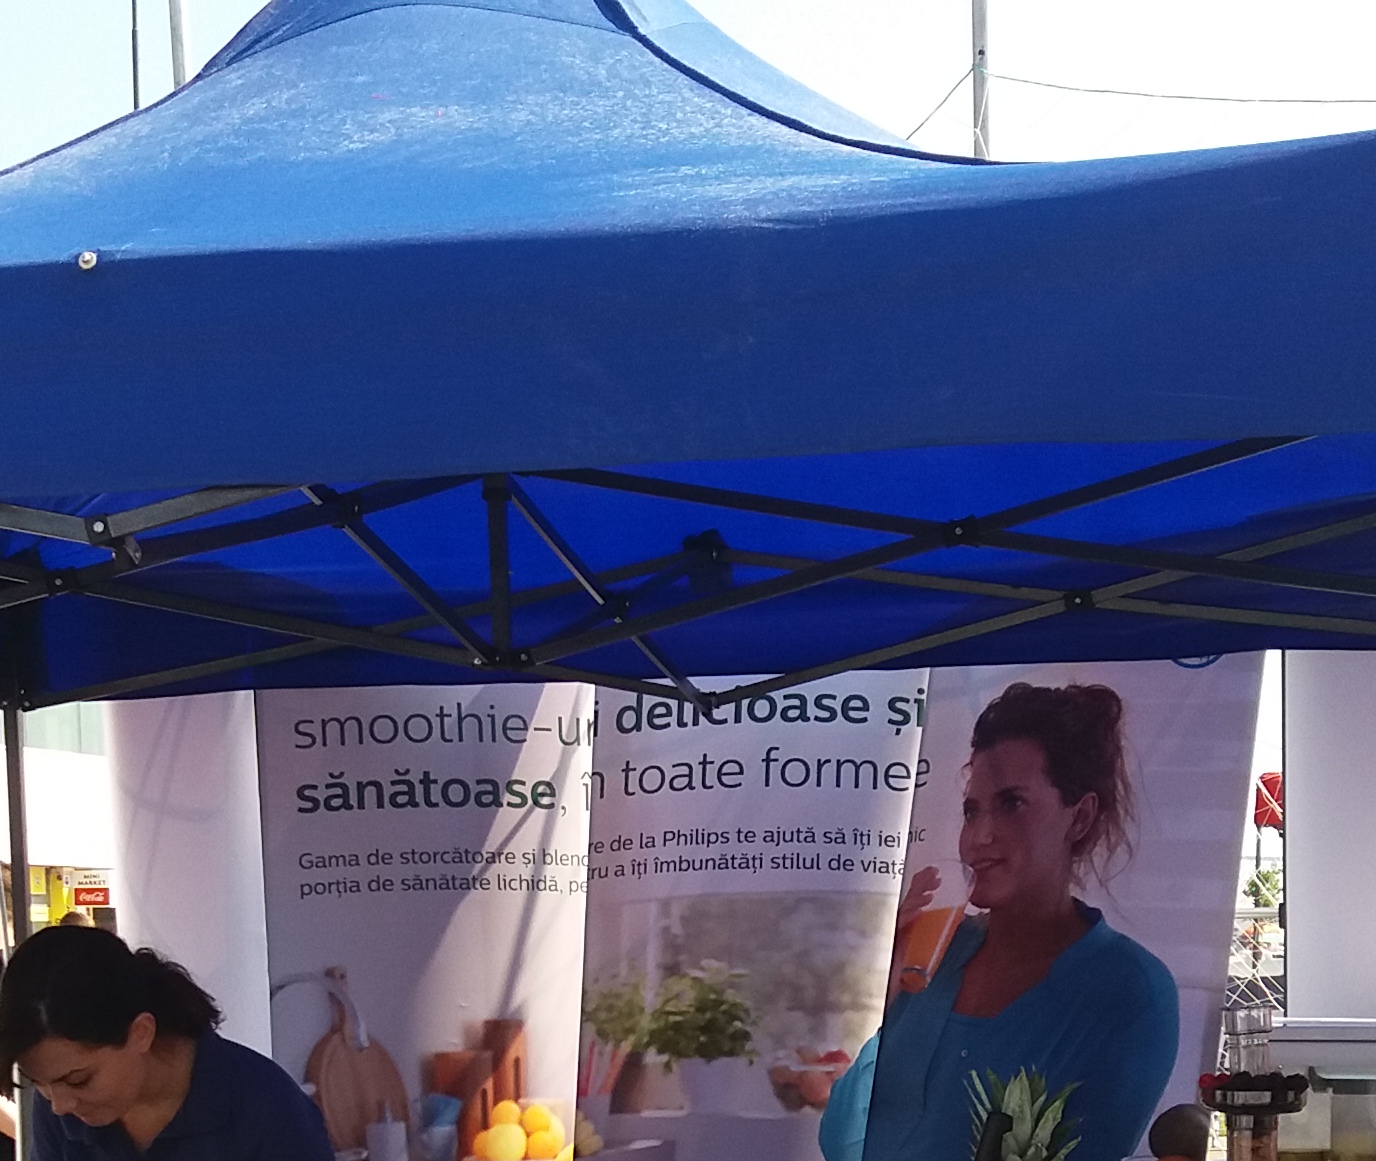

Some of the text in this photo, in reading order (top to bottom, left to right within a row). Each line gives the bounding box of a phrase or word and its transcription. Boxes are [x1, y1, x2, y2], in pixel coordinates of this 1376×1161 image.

[295, 767, 568, 817] sănătoase,
[621, 752, 745, 798] toate
[297, 852, 361, 871] Gama
[366, 849, 394, 866] de
[399, 846, 517, 867] storcătoare
[609, 834, 635, 853] de
[638, 832, 657, 850] la
[661, 828, 731, 851] Philips
[735, 826, 758, 844] te
[762, 826, 817, 851] ajută
[822, 827, 848, 846] să
[877, 830, 902, 849] iei
[367, 872, 396, 893] de
[400, 872, 491, 893] sănătate
[496, 872, 564, 896] lichidă,
[613, 862, 626, 878] a
[769, 850, 822, 871] stilul
[827, 853, 856, 873] de
